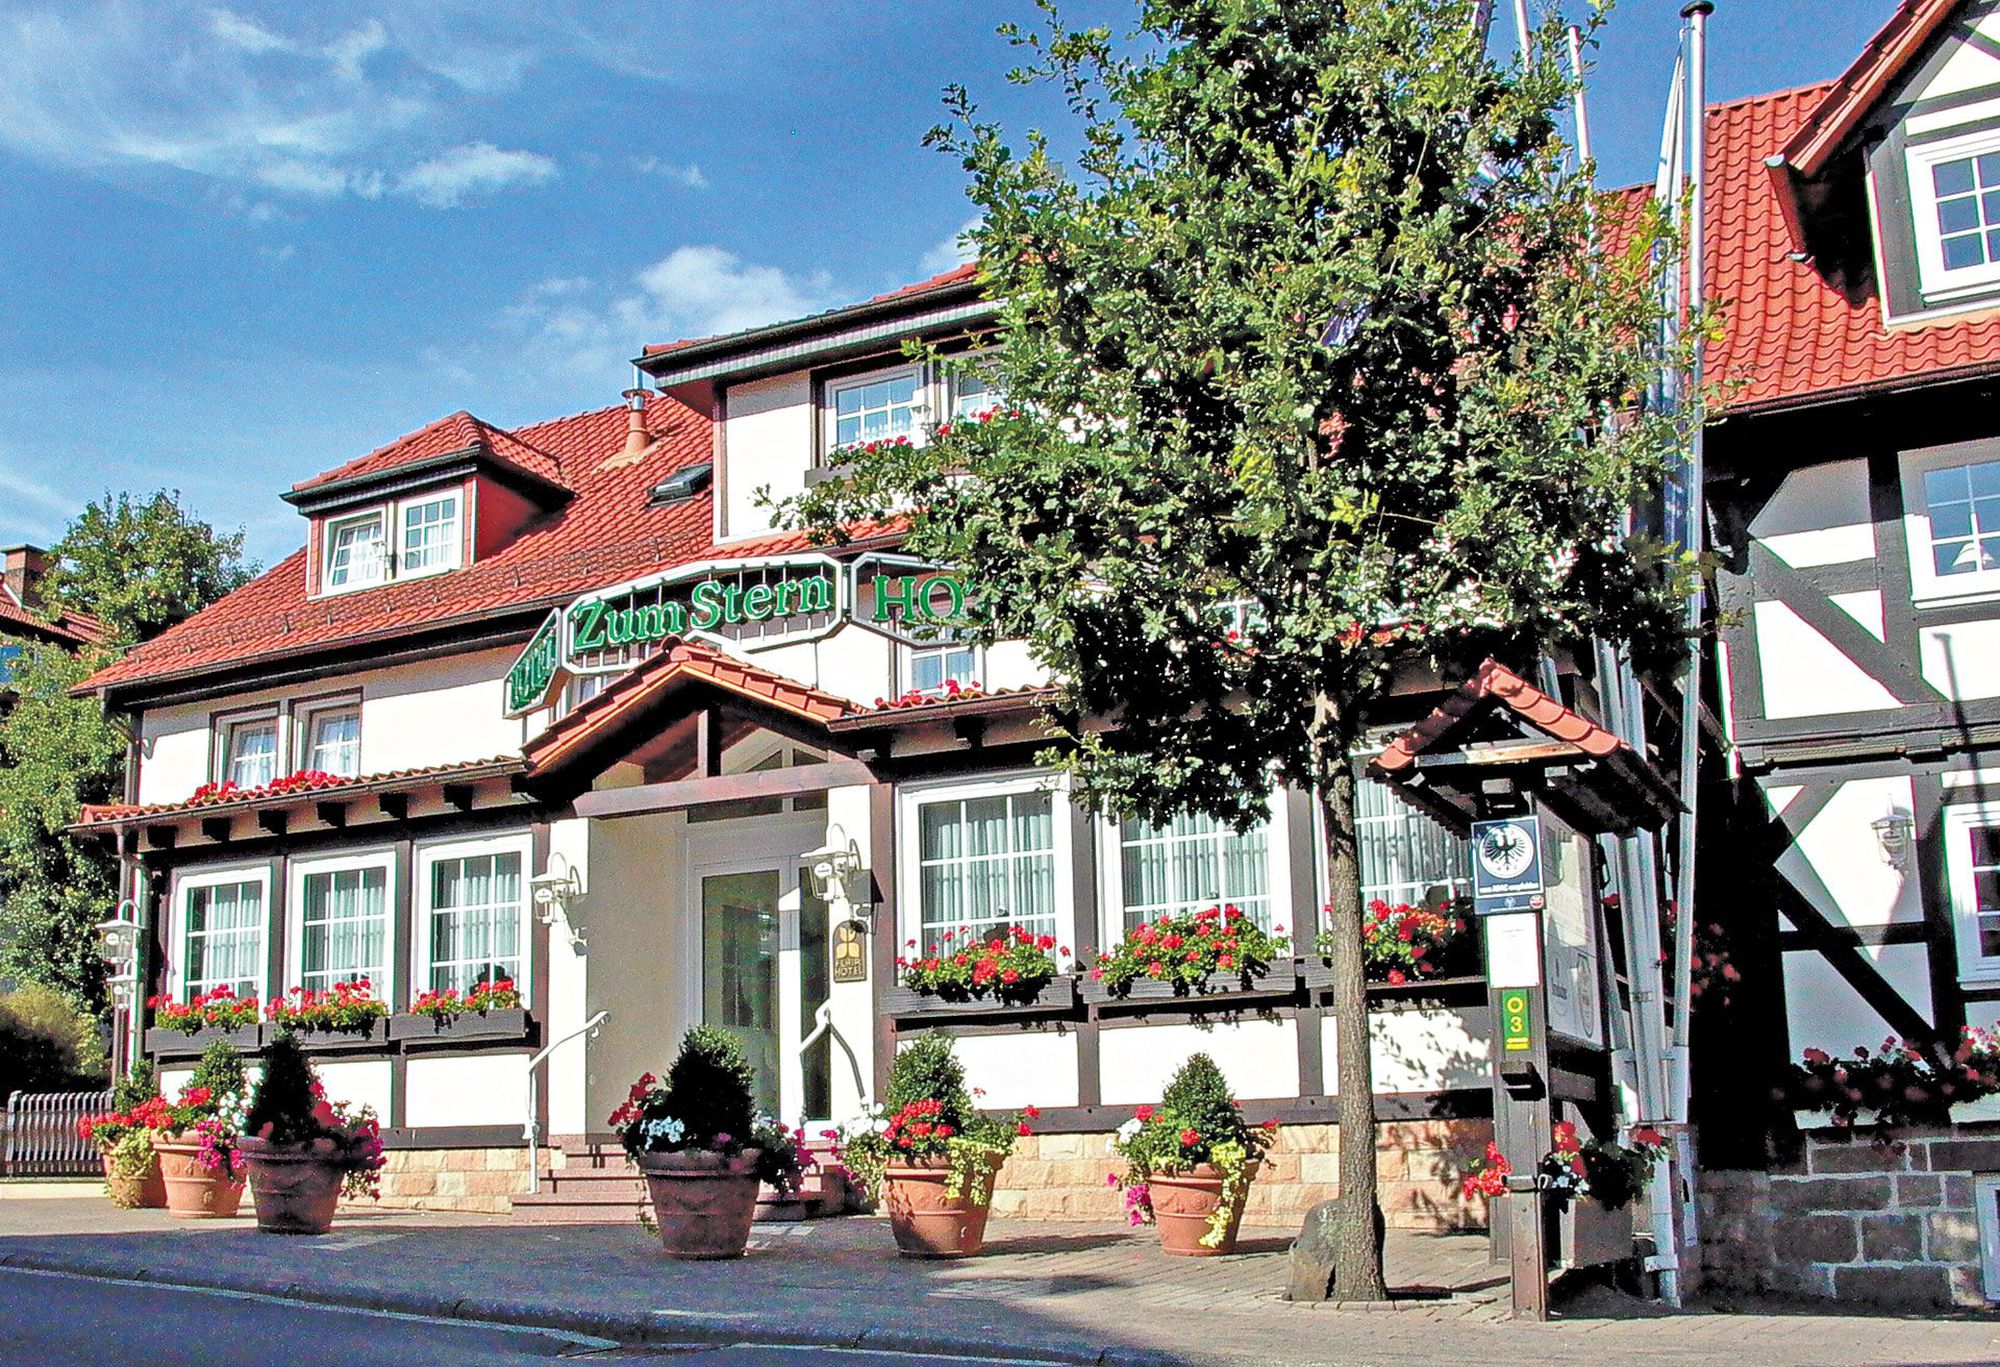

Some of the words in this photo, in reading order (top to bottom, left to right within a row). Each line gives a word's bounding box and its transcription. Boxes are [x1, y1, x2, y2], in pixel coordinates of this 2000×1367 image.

[573, 599, 685, 650] Zum
[690, 575, 831, 630] Stern
[1511, 1016, 1522, 1032] 3
